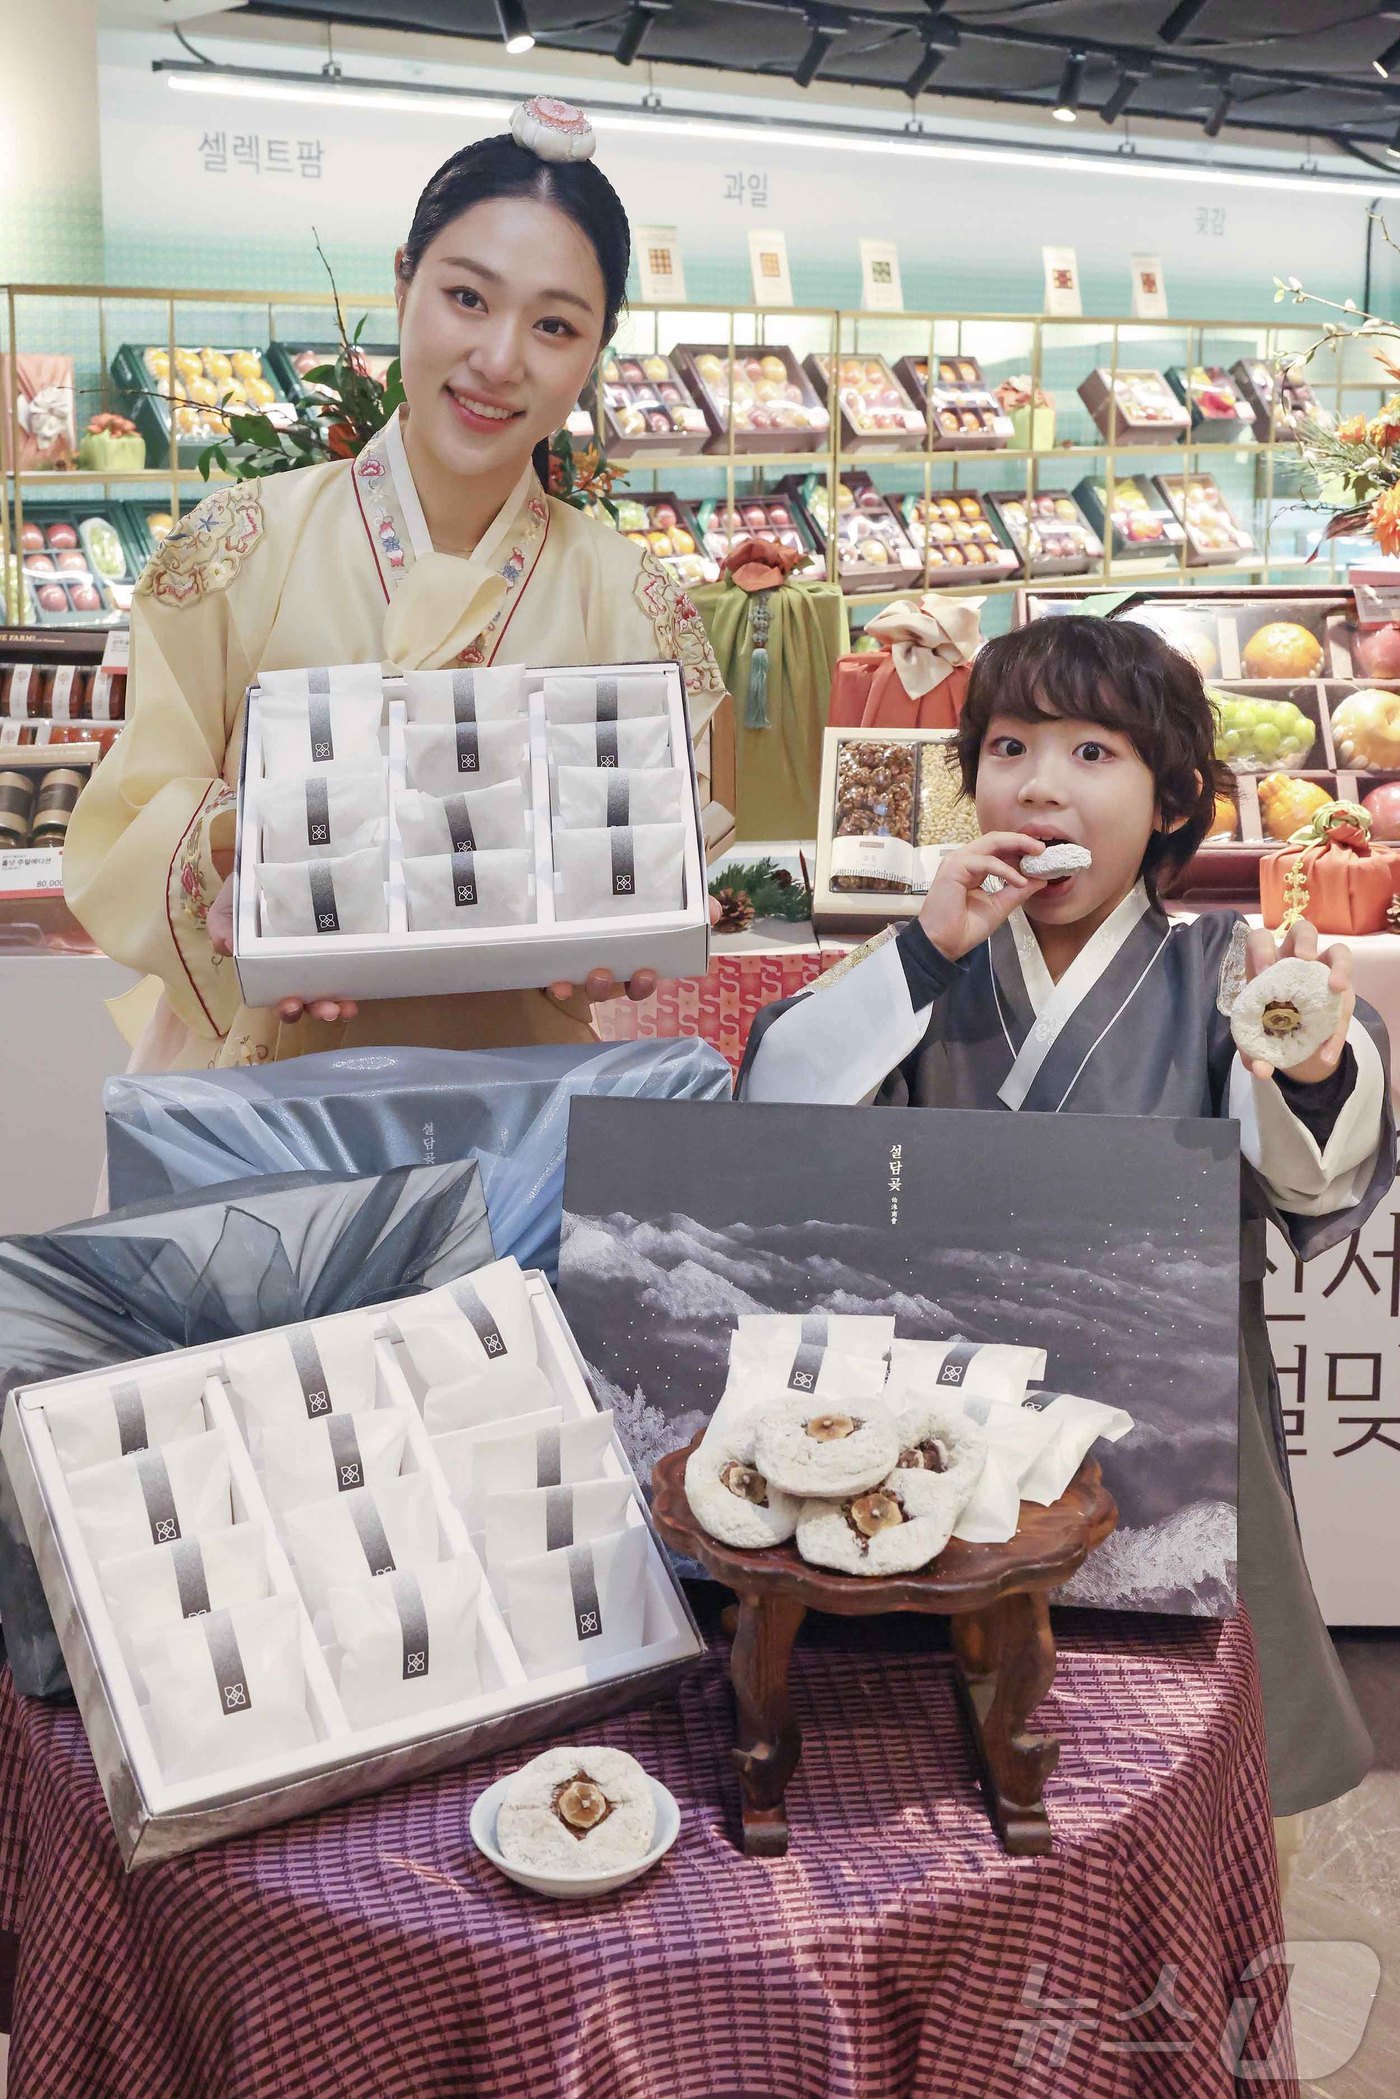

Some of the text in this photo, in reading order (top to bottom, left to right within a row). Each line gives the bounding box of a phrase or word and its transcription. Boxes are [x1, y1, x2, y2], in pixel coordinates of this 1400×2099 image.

[198, 131, 325, 179] 셀렉트팜
[723, 171, 768, 208] 과일
[422, 1120, 436, 1165] 설담곶
[887, 1144, 903, 1192] 설담곶
